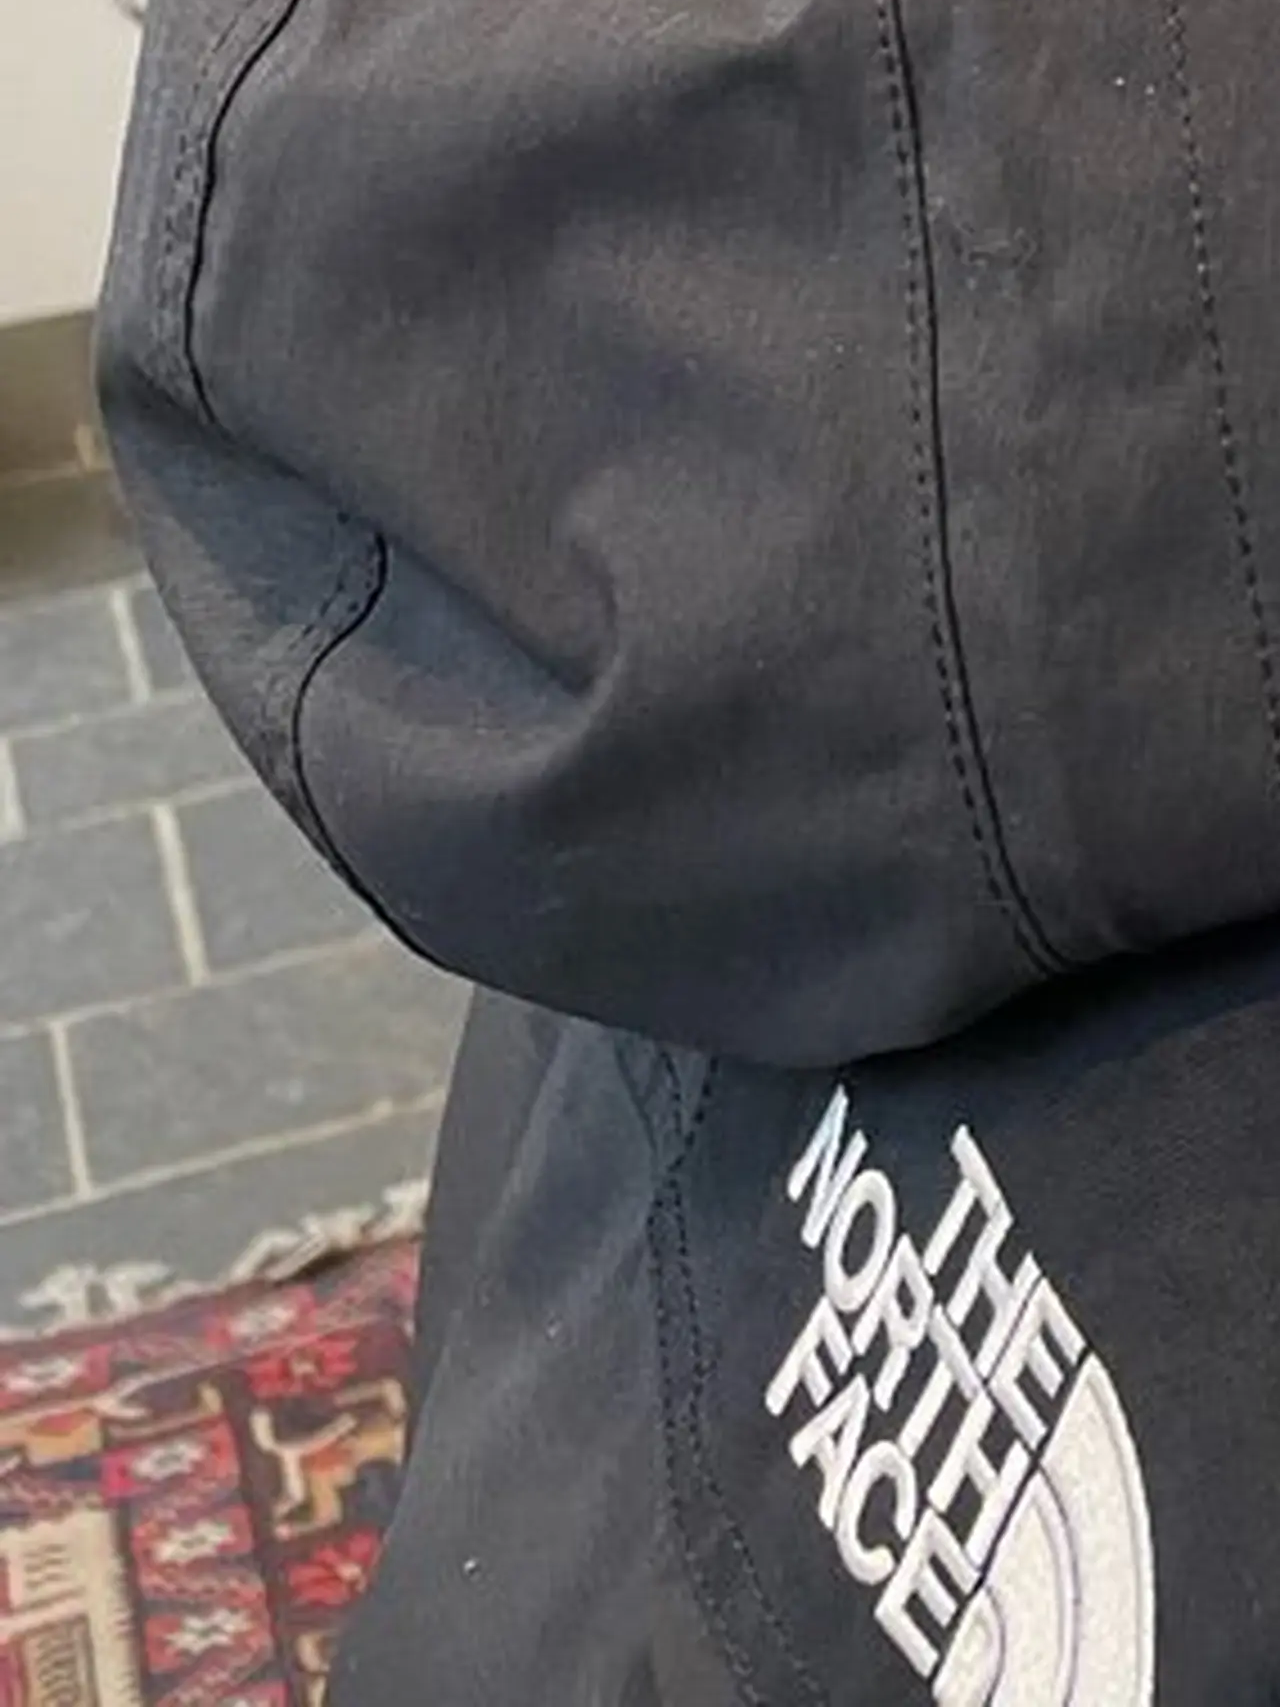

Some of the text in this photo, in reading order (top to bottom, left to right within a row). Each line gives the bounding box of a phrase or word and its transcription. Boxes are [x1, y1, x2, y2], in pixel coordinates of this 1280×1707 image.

[787, 1085, 1030, 1573] NORTH
[924, 1125, 1086, 1450] THE
[765, 1298, 982, 1678] FACE
